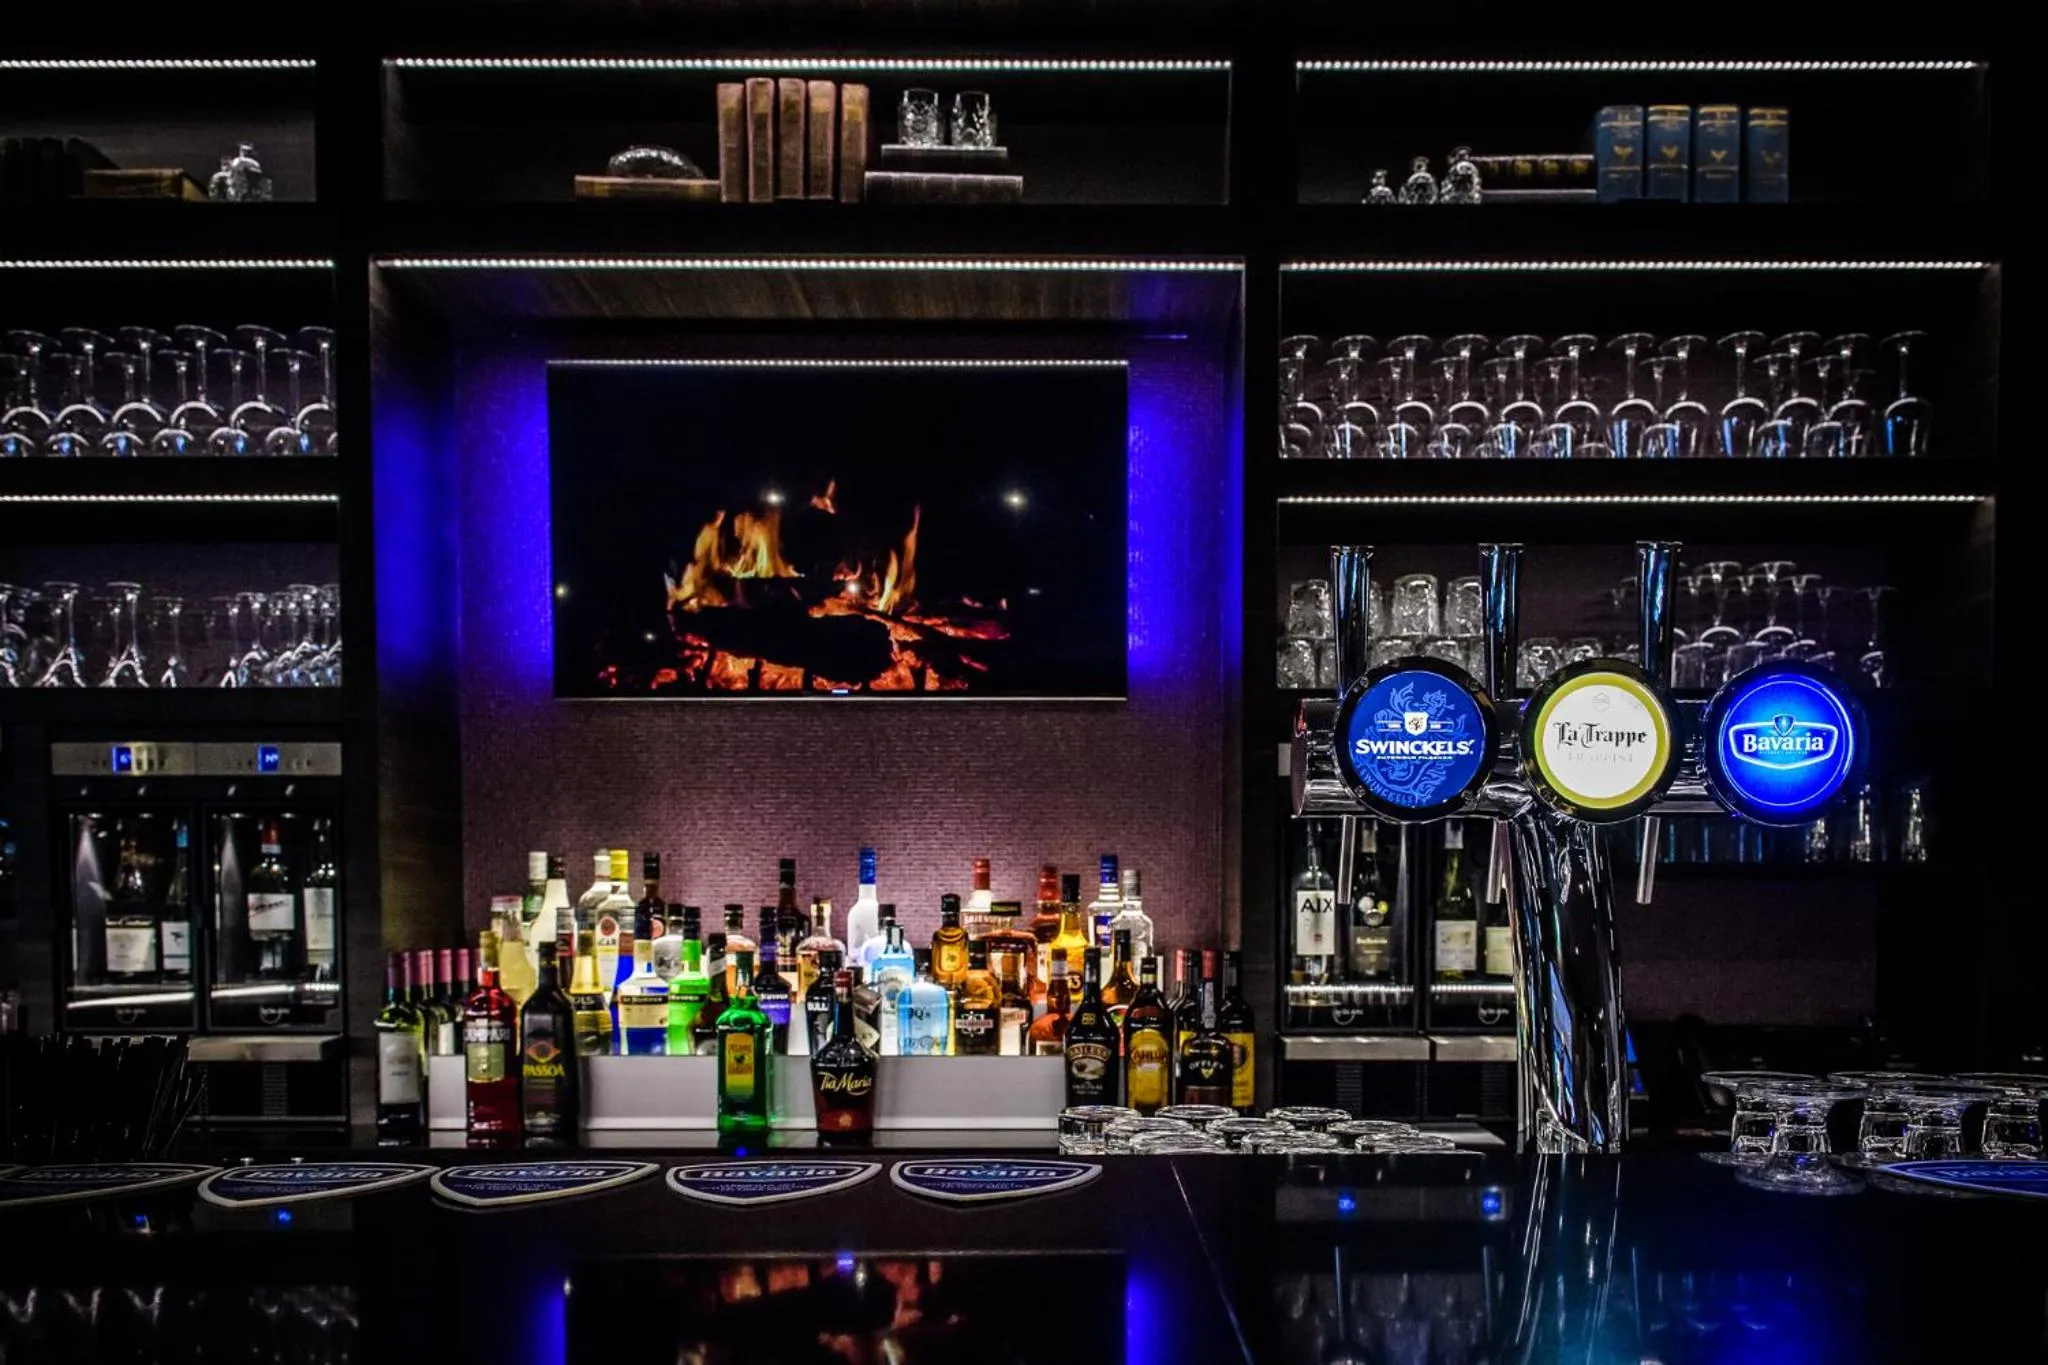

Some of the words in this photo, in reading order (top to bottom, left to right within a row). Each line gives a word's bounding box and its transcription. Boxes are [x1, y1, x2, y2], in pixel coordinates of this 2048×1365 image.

[1553, 721, 1578, 750] La
[1581, 722, 1648, 749] Trappe
[1743, 732, 1824, 753] Bavaria
[1300, 898, 1333, 913] AIX
[818, 1071, 837, 1091] Tia
[836, 1072, 872, 1095] Maria
[245, 1168, 384, 1179] Bavaria
[467, 1166, 607, 1177] Bavaria
[698, 1166, 839, 1179] Bavaria
[922, 1165, 1058, 1178] Bavaria
